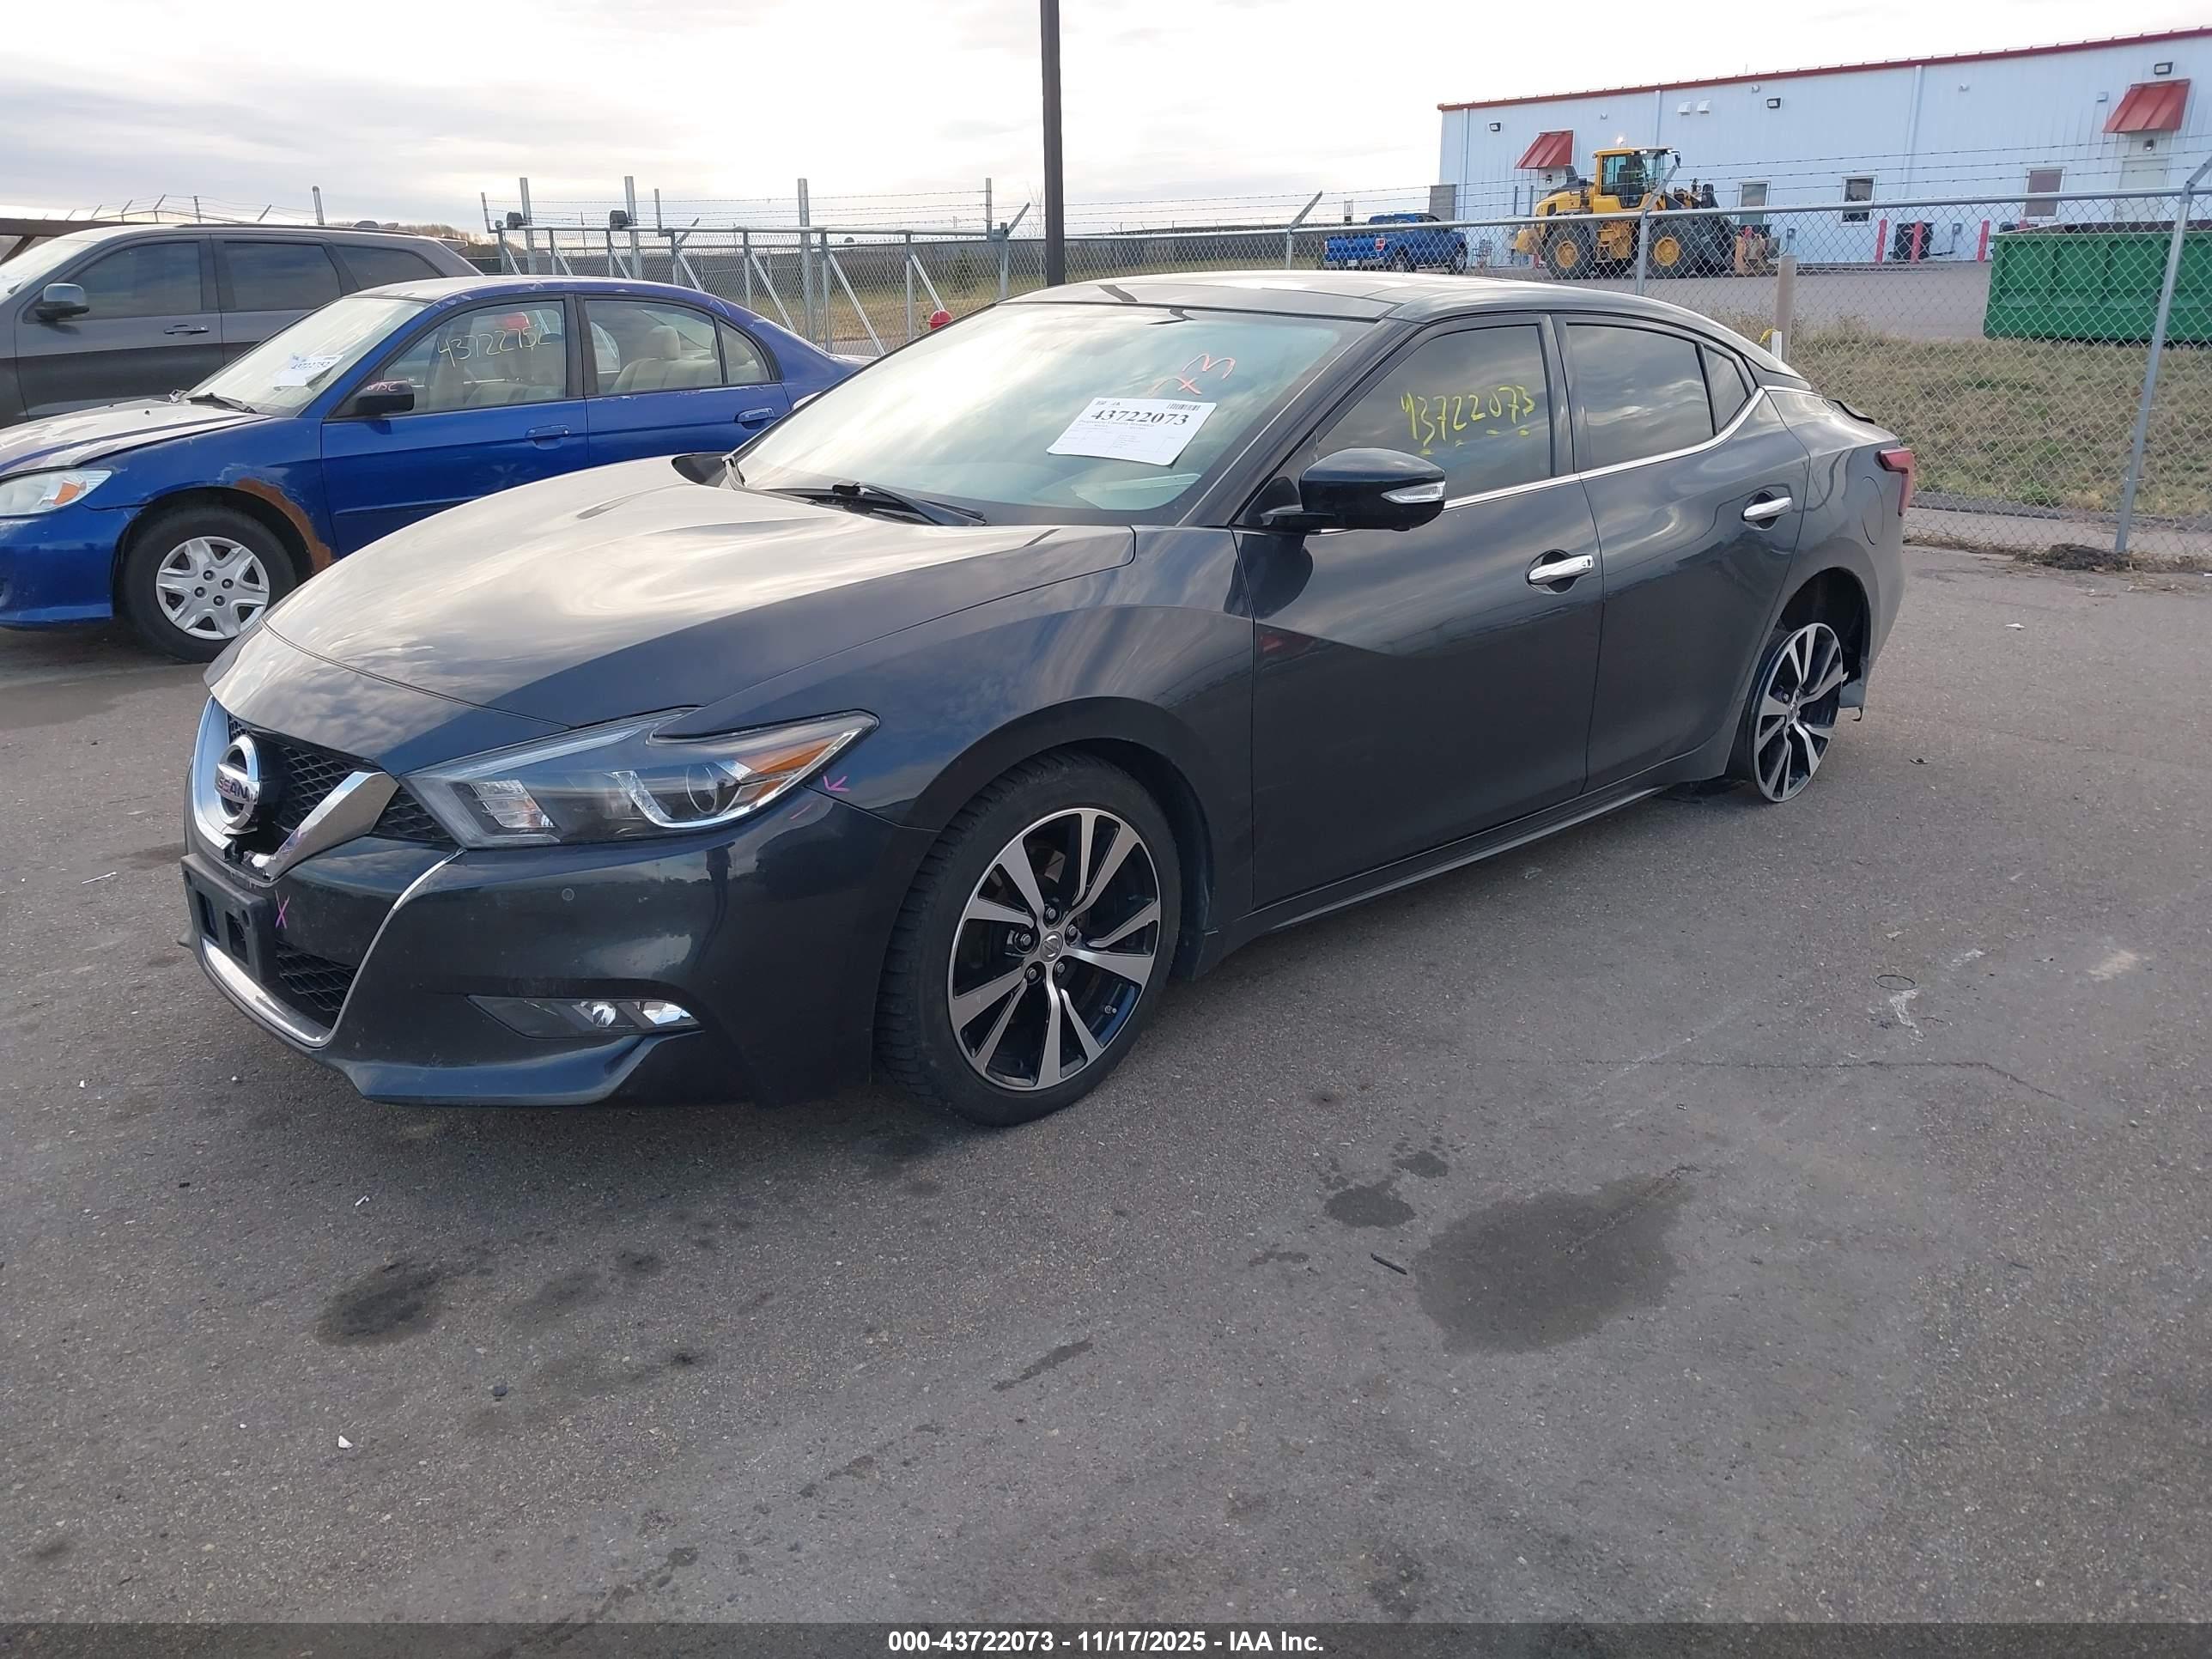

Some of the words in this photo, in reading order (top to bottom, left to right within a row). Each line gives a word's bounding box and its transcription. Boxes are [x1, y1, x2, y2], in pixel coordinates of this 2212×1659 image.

[436, 324, 551, 368] 43722752
[1091, 410, 1190, 426] 43722073
[1400, 385, 1536, 447] 43722073
